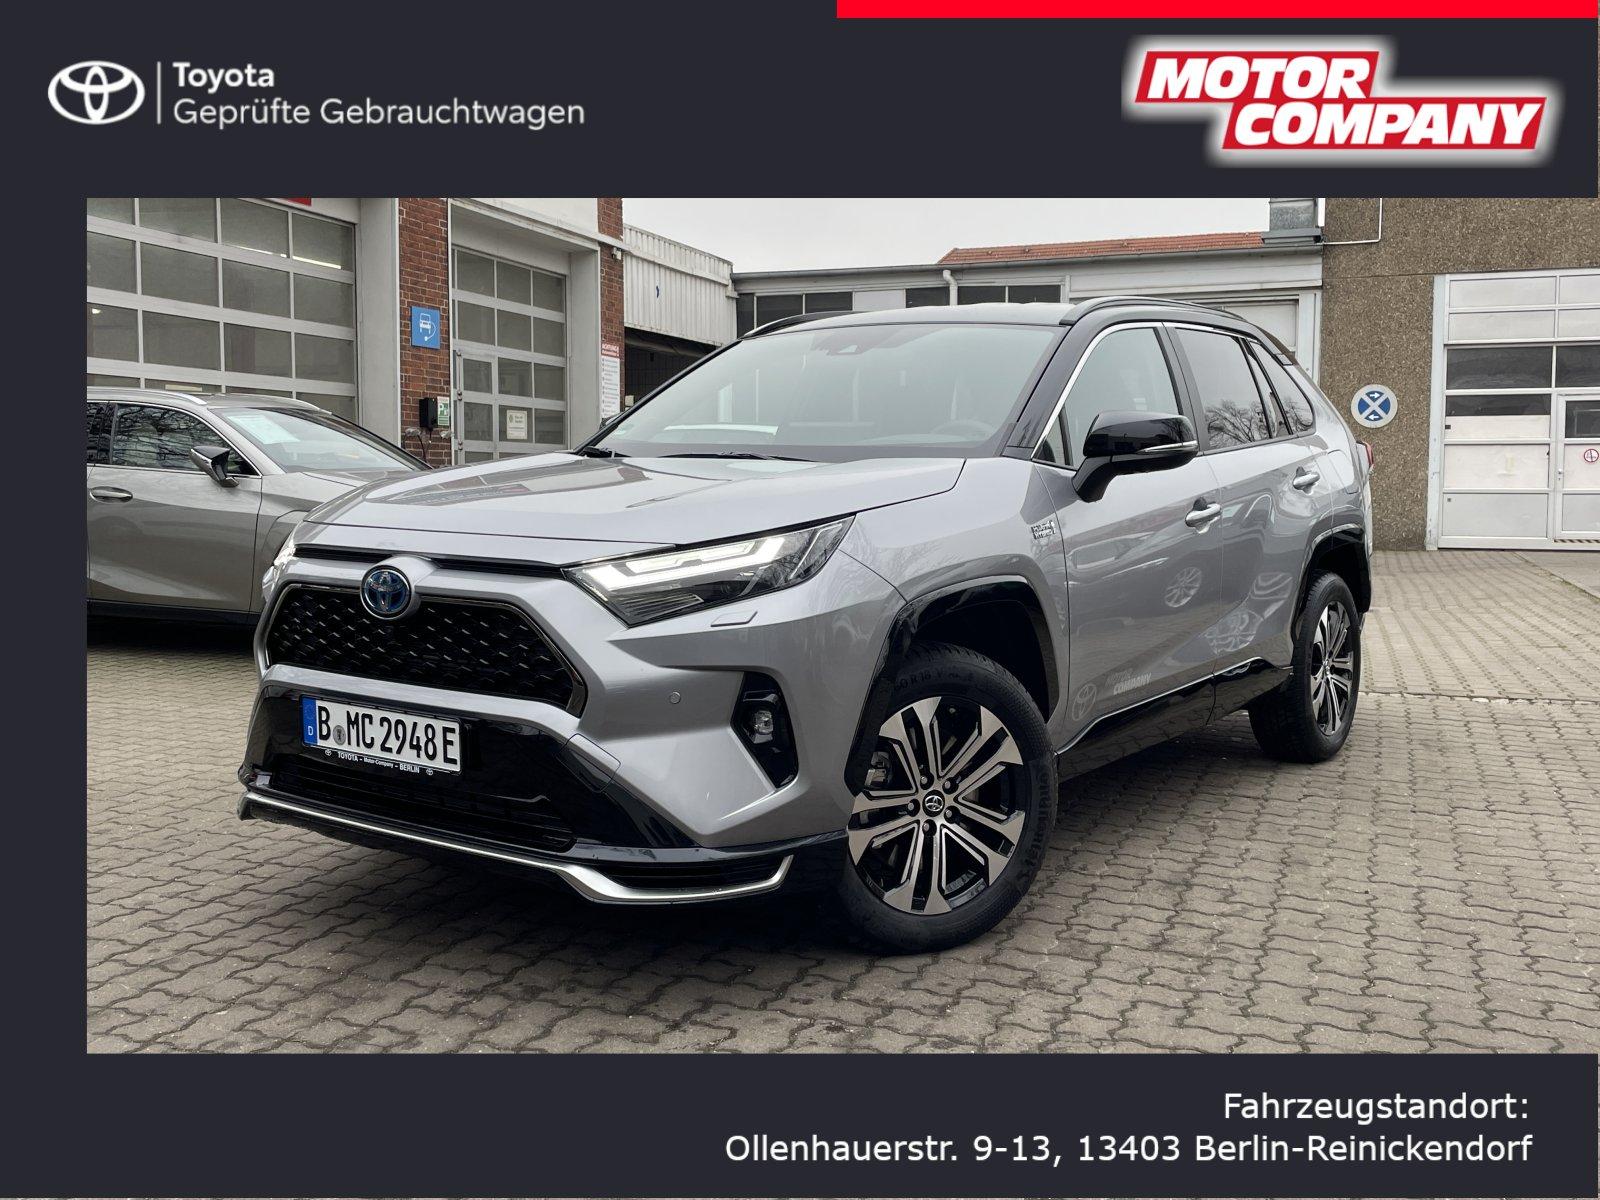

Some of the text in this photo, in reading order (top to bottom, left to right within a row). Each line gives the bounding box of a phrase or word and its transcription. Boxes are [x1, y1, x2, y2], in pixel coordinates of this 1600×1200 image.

[1113, 672, 1152, 695] COMPANY
[308, 726, 314, 736] D
[318, 705, 331, 741] B
[346, 710, 375, 749] MC
[338, 751, 359, 763] TOYOTA
[363, 756, 394, 769] Motor-Company
[399, 763, 420, 774] BERLIN
